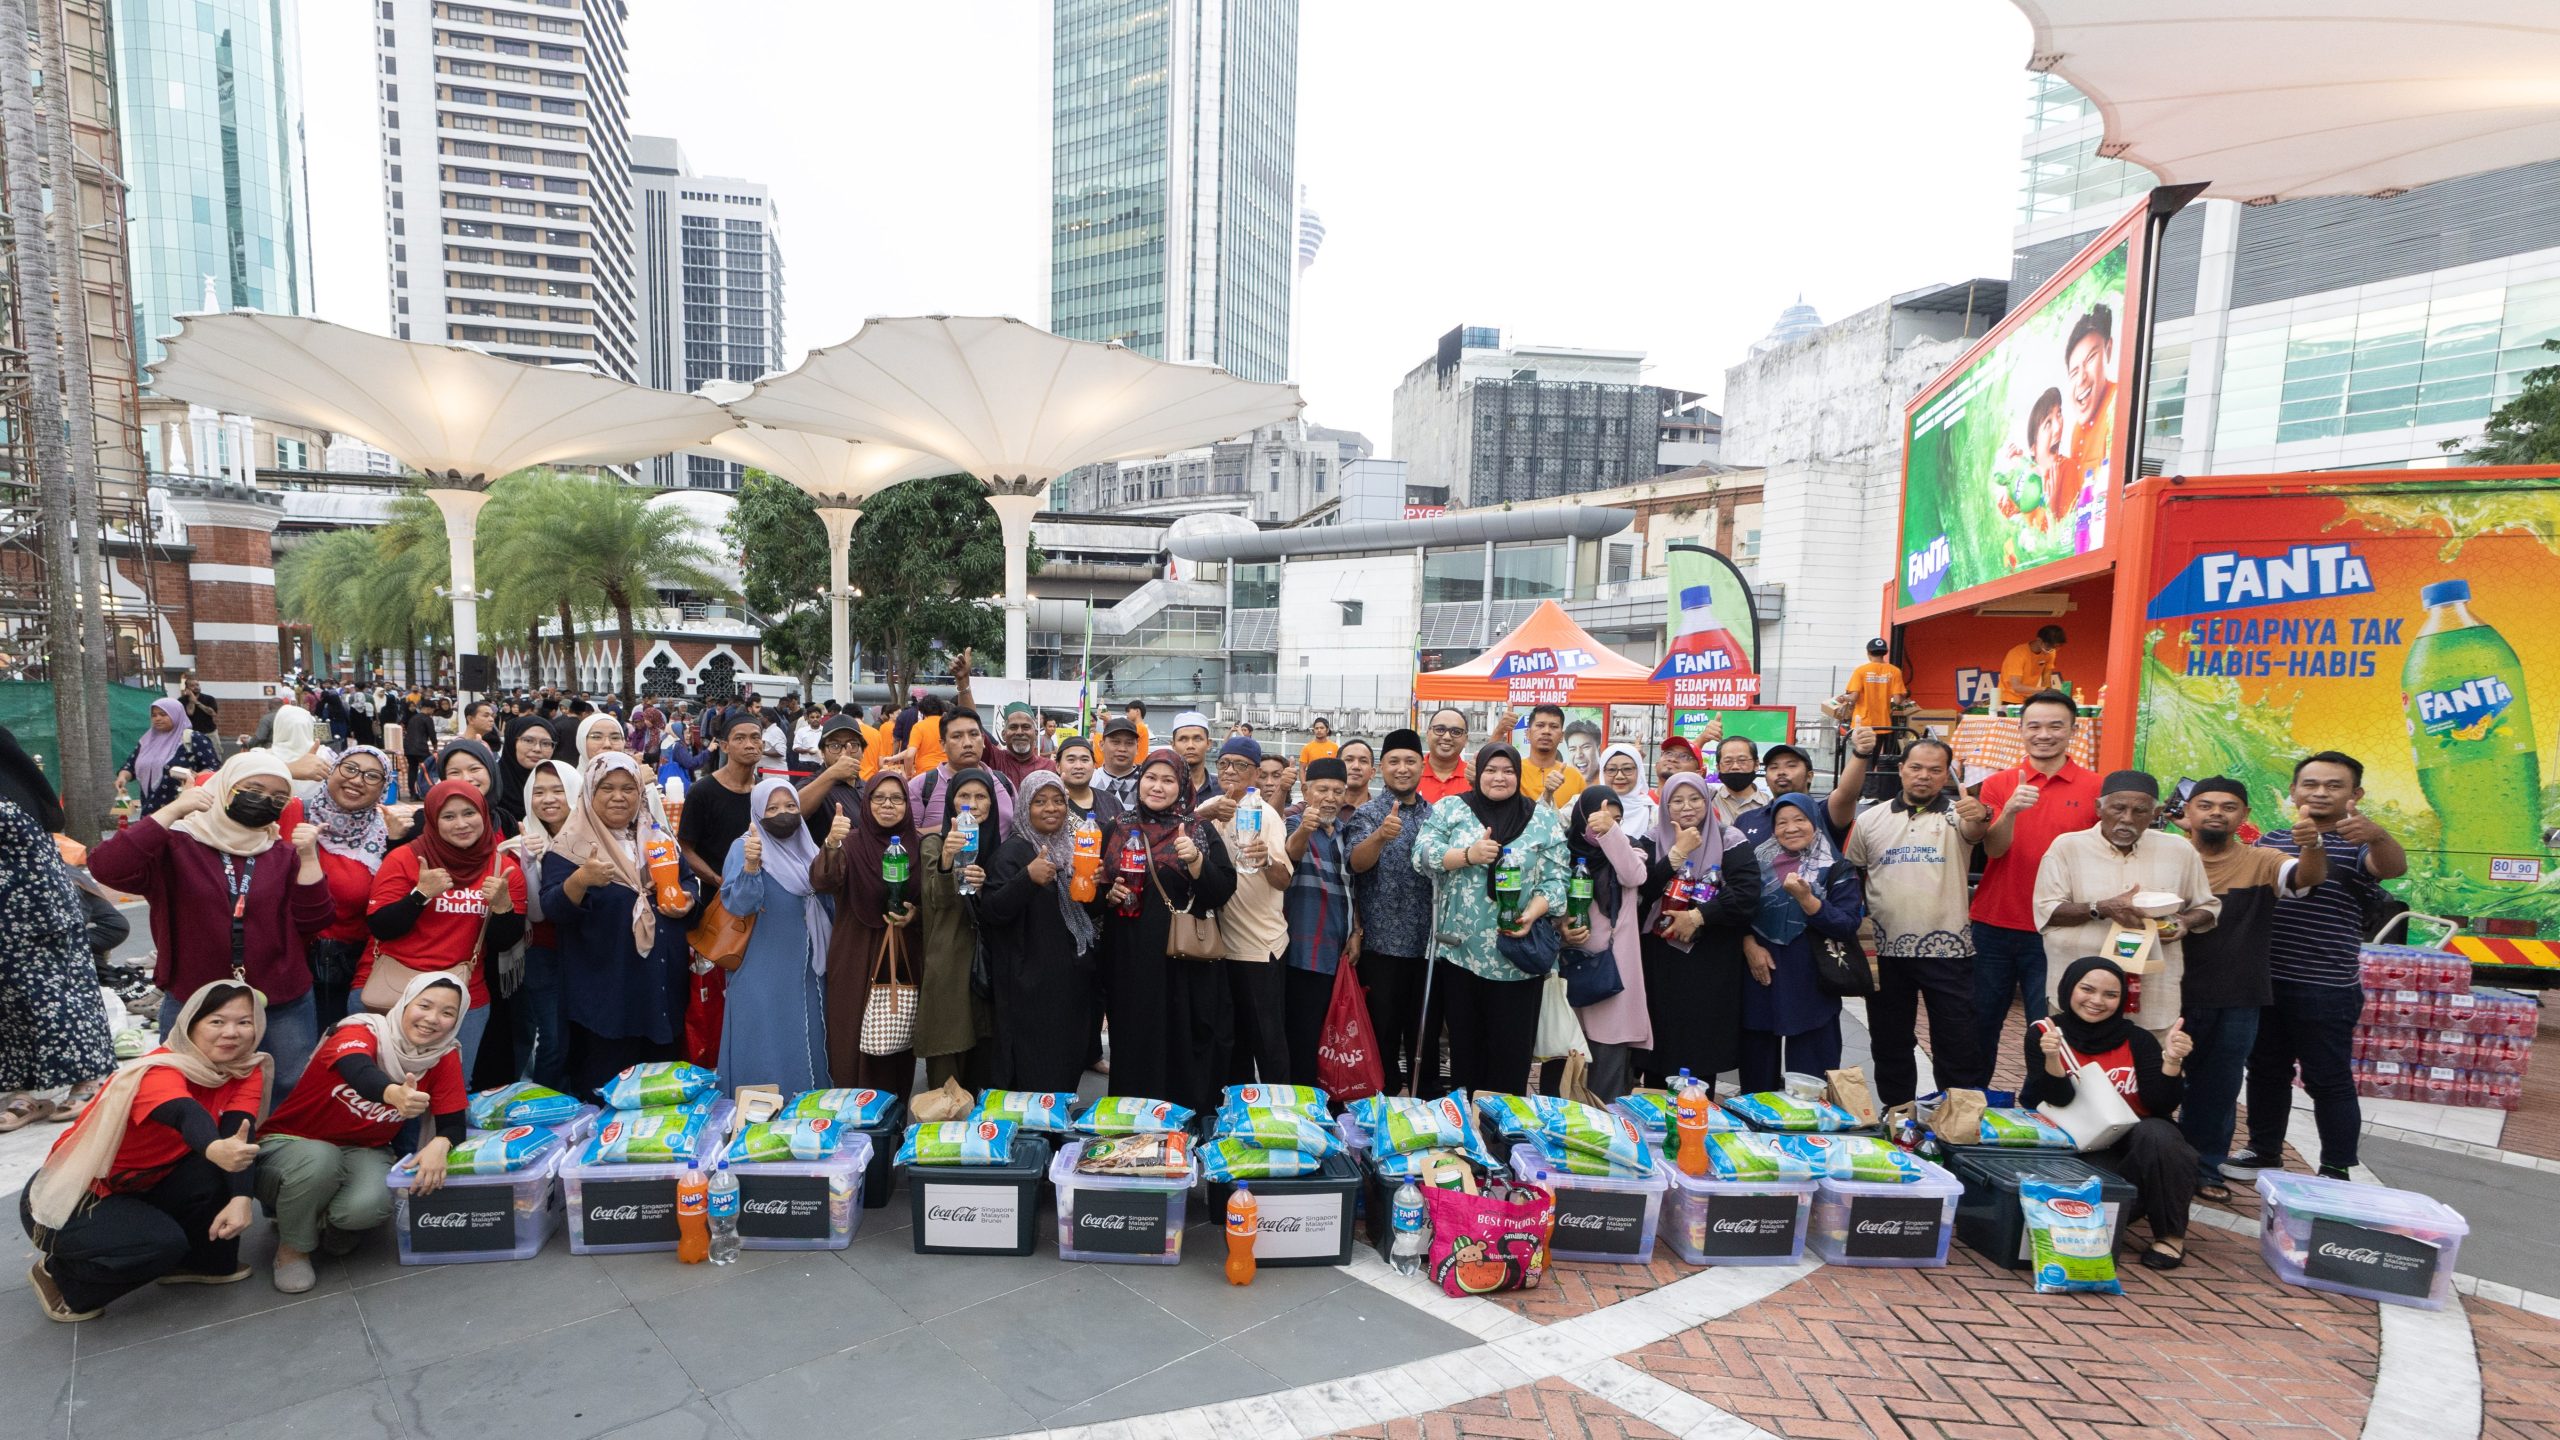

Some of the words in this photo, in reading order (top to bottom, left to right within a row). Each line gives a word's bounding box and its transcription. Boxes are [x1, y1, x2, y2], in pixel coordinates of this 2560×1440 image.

[1907, 535, 1950, 587] FANTA
[2203, 546, 2370, 603] FANTA
[2190, 618, 2337, 645] SEDAPNYA
[2349, 618, 2405, 645] TAK
[1509, 652, 1554, 673] FANTA
[1675, 650, 1732, 674] FANTA
[2187, 650, 2376, 677] HABIS-HABIS
[1509, 678, 1556, 690] SEDAPNYA
[1558, 678, 1575, 690] TAK
[1674, 678, 1732, 692] SEDAPNYA
[1736, 678, 1757, 691] TAK
[1508, 691, 1567, 703] HABIS-HABIS
[1674, 694, 1747, 707] HABIS-HABIS
[2416, 676, 2512, 721] FANTA
[1684, 713, 1709, 723] FANTA
[1886, 846, 1910, 856] MASJID
[1913, 846, 1938, 854] JAMEK
[2493, 861, 2509, 871] 80
[2518, 864, 2532, 874] 90
[442, 887, 485, 901] Coke
[435, 898, 489, 918] Buddy
[712, 1193, 735, 1204] FANTA
[590, 1205, 639, 1221] Coca-Cola
[743, 1199, 789, 1214] Coca-Cola
[928, 1205, 979, 1222] Coca-Cola
[417, 1212, 469, 1228] Coca-Cola
[1080, 1213, 1127, 1229] Coca-Cola
[1400, 1210, 1420, 1219] FANTA
[1559, 1213, 1606, 1229] Coca-Cola
[1713, 1218, 1760, 1233] Coca-Cola
[1856, 1219, 1903, 1234] Coca-Cola
[2319, 1242, 2382, 1264] Coca-Cola
